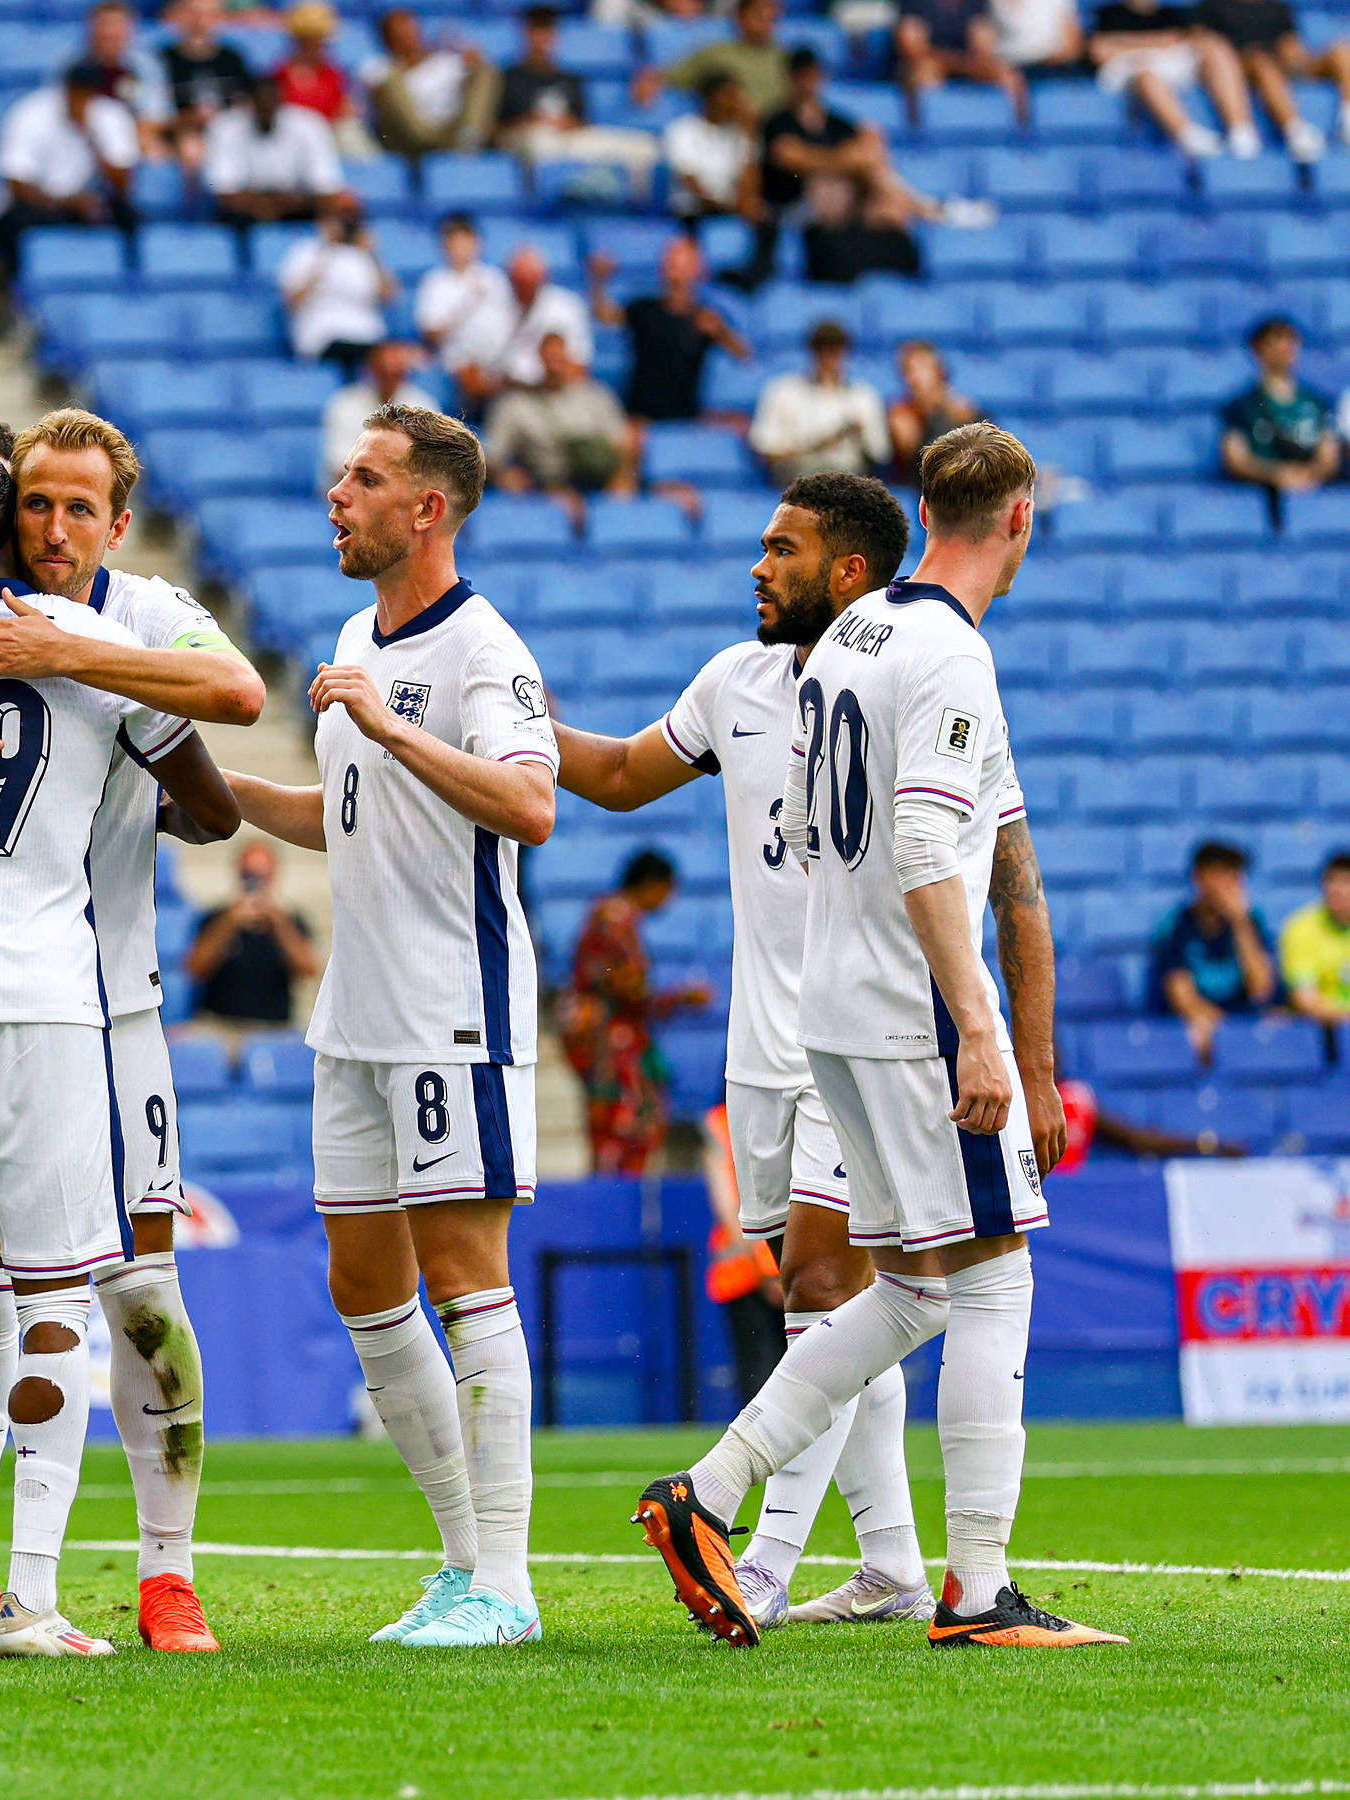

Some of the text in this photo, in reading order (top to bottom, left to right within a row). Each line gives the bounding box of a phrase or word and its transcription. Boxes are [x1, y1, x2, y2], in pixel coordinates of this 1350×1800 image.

[829, 610, 893, 657] PALMER
[341, 763, 359, 837] 8
[799, 677, 873, 872] 20
[763, 798, 788, 871] 3
[145, 1094, 169, 1168] 9
[415, 1071, 451, 1145] 8
